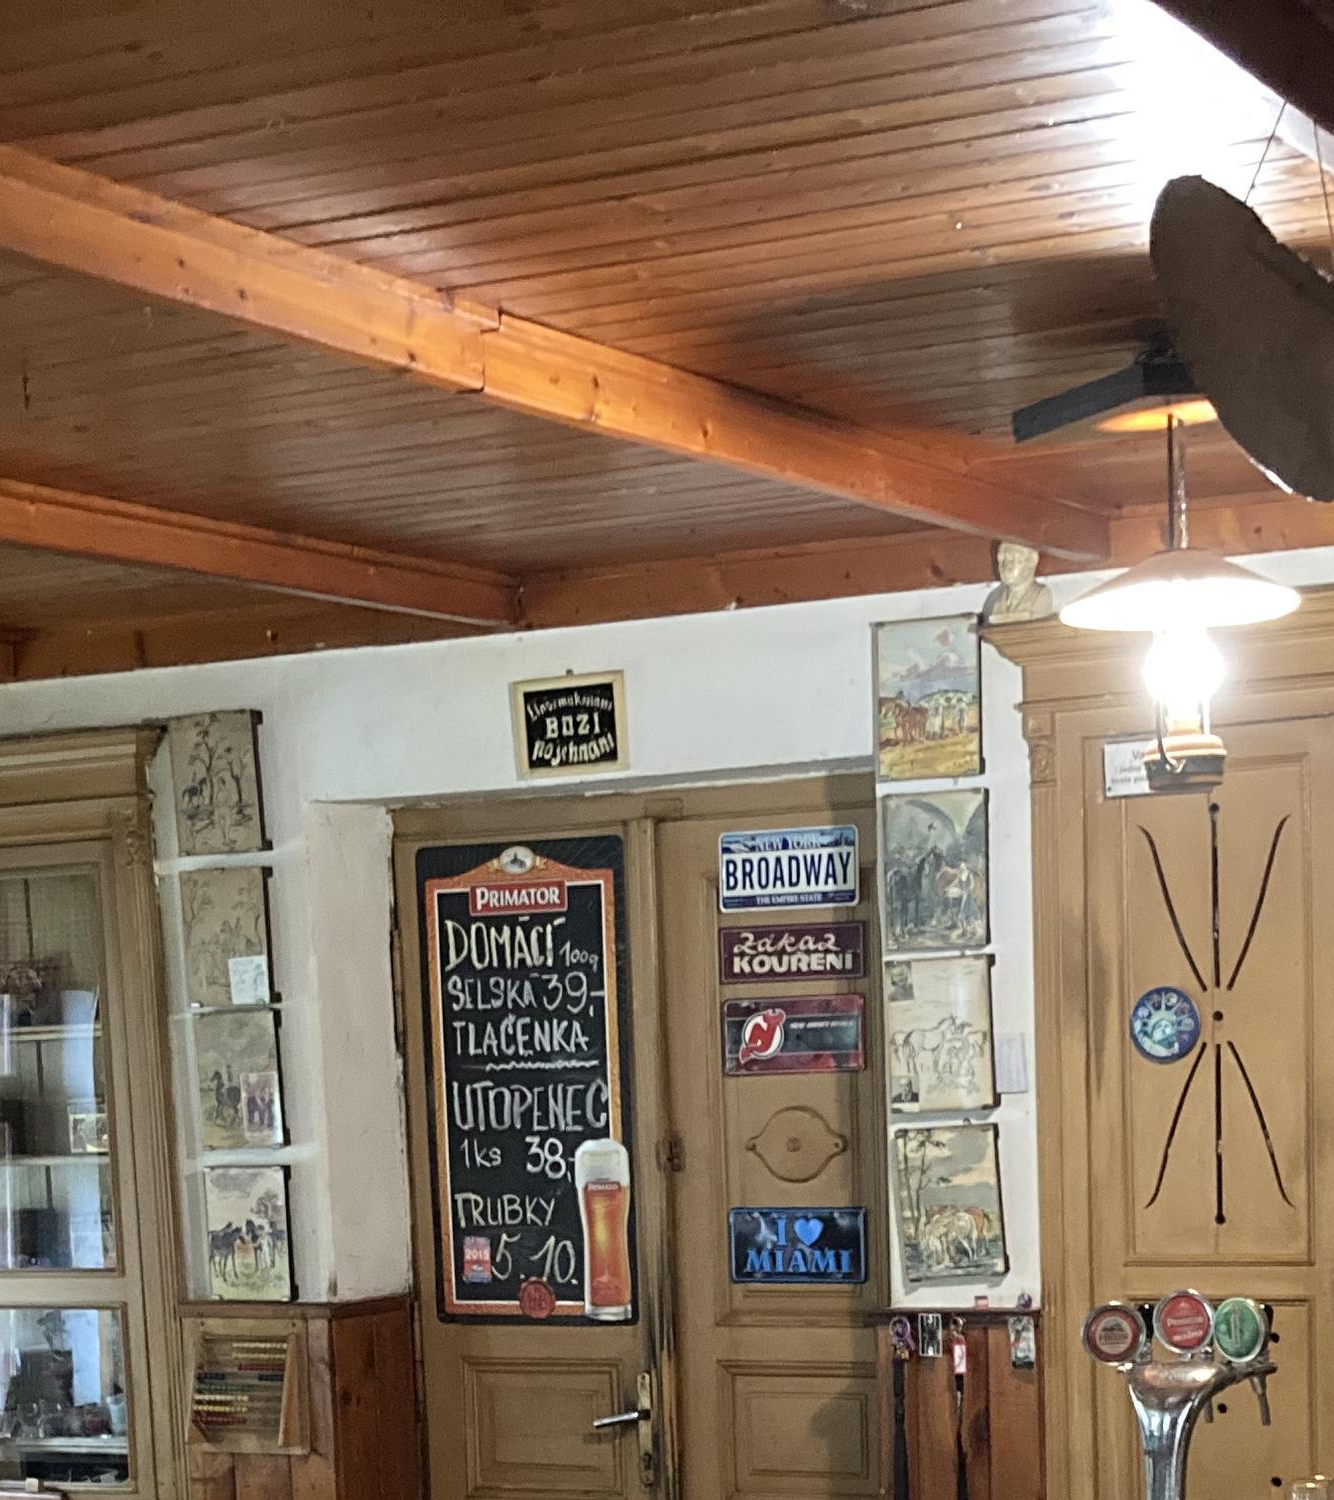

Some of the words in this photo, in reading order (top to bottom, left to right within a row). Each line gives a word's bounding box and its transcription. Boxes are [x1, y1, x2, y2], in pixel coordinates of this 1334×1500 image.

[725, 851, 851, 891] BROADWAY
[559, 941, 599, 972] 100g
[453, 1013, 589, 1057] TLAČENKA
[452, 1078, 609, 1133] UTOPENEC
[459, 1138, 502, 1169] 1ks
[454, 1192, 555, 1229] TRUBKY
[774, 1216, 788, 1246] I
[744, 1249, 853, 1273] MIAMI
